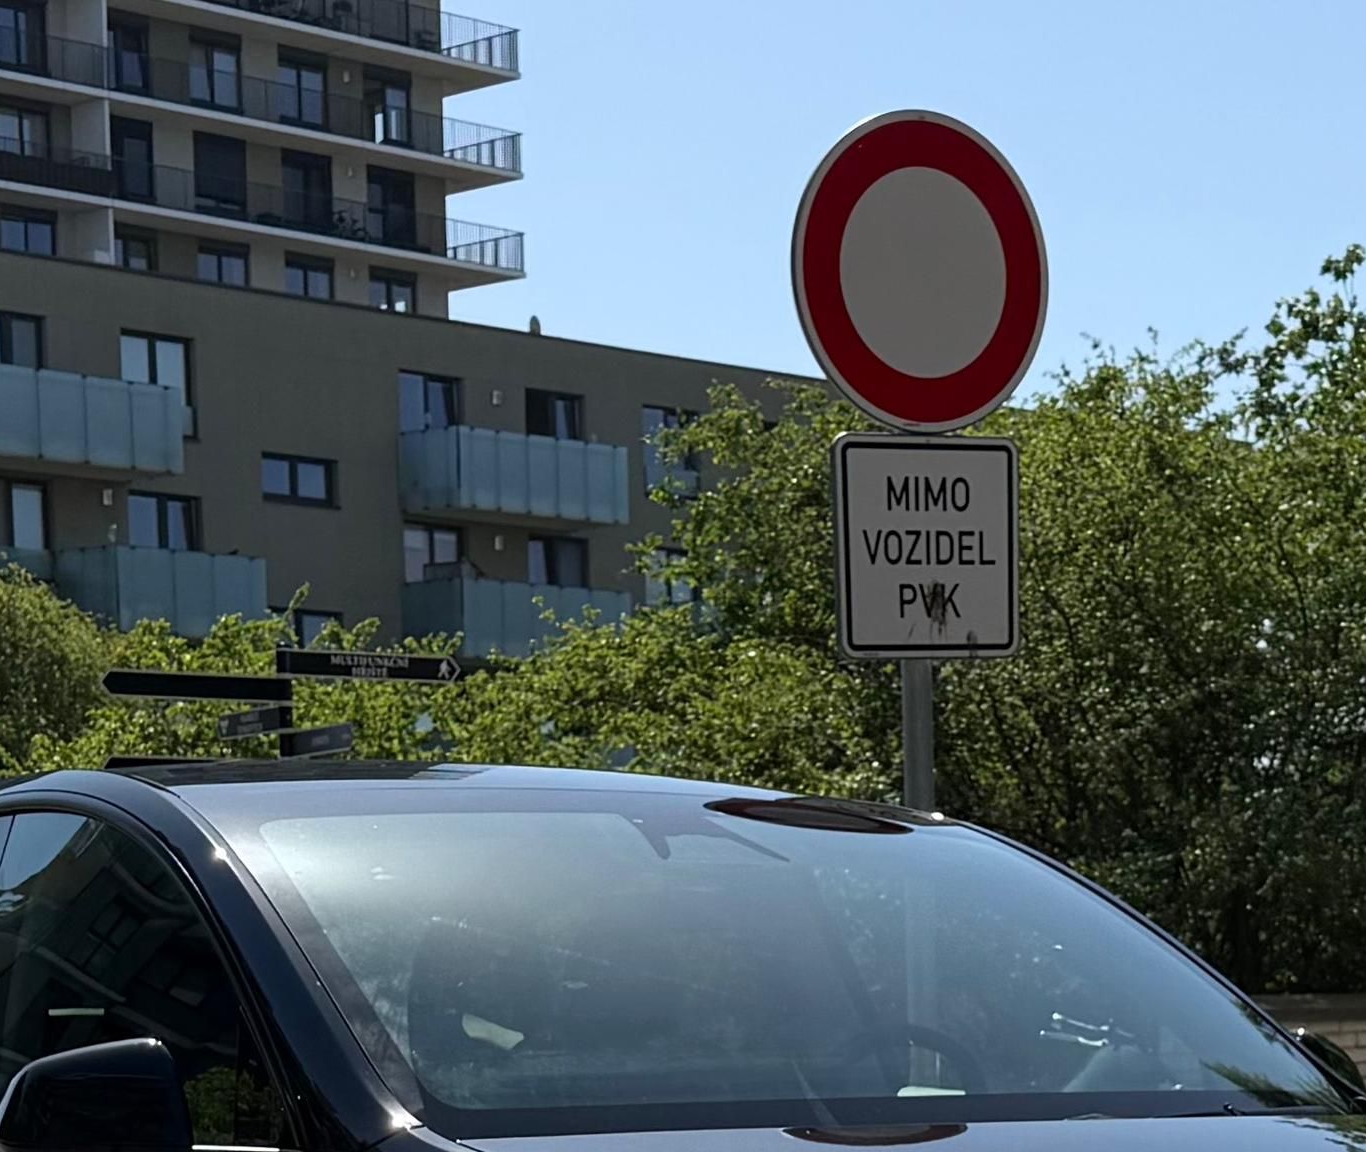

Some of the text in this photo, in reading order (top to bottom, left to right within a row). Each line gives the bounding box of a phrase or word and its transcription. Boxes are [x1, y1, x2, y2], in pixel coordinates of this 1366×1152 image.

[887, 475, 970, 512] MIMO
[862, 529, 996, 566] VOZIDEL
[899, 583, 961, 619] PVK
